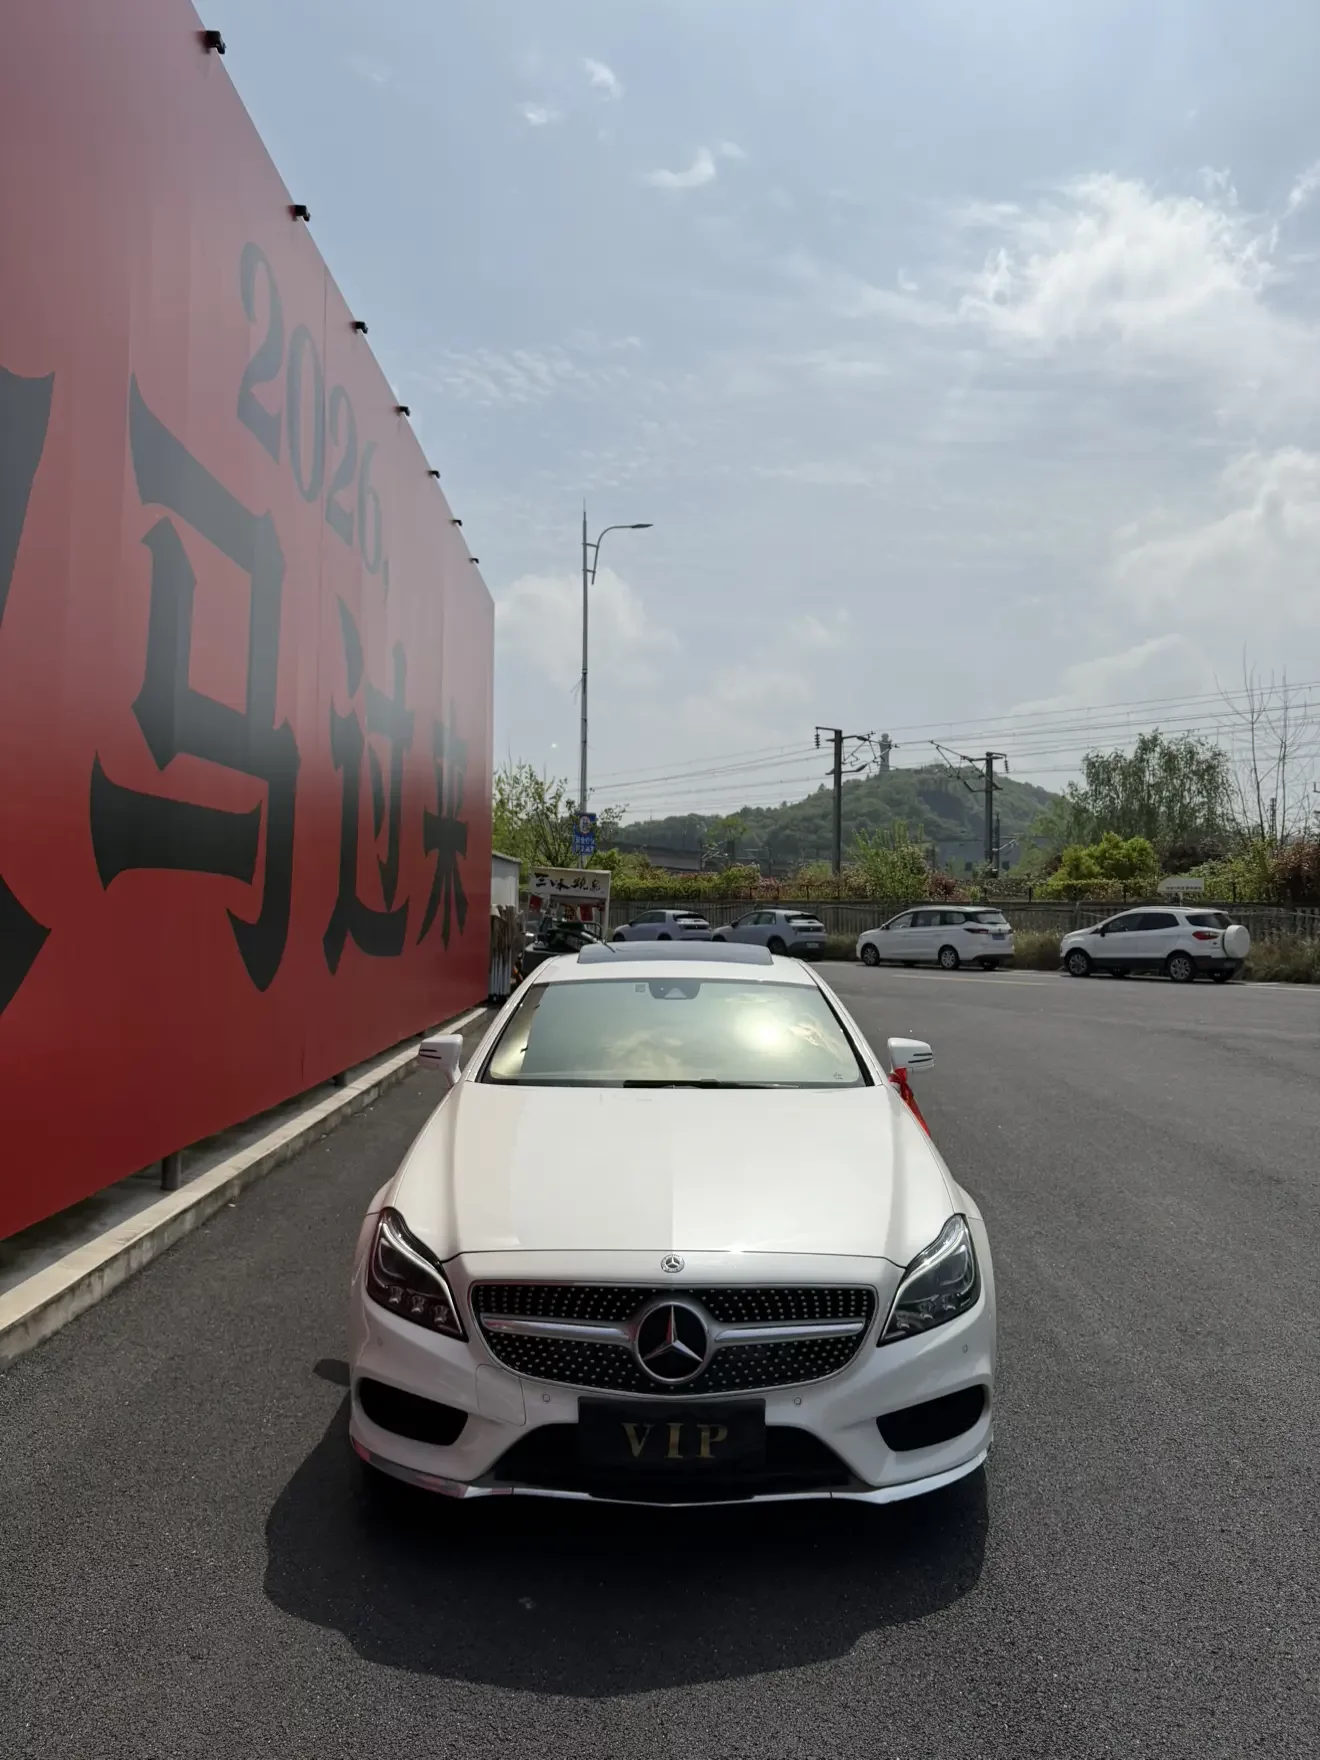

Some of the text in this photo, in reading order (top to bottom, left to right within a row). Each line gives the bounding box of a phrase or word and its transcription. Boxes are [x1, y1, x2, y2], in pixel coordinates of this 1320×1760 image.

[0, 366, 470, 1016] 马过来
[621, 1422, 728, 1459] VIP
